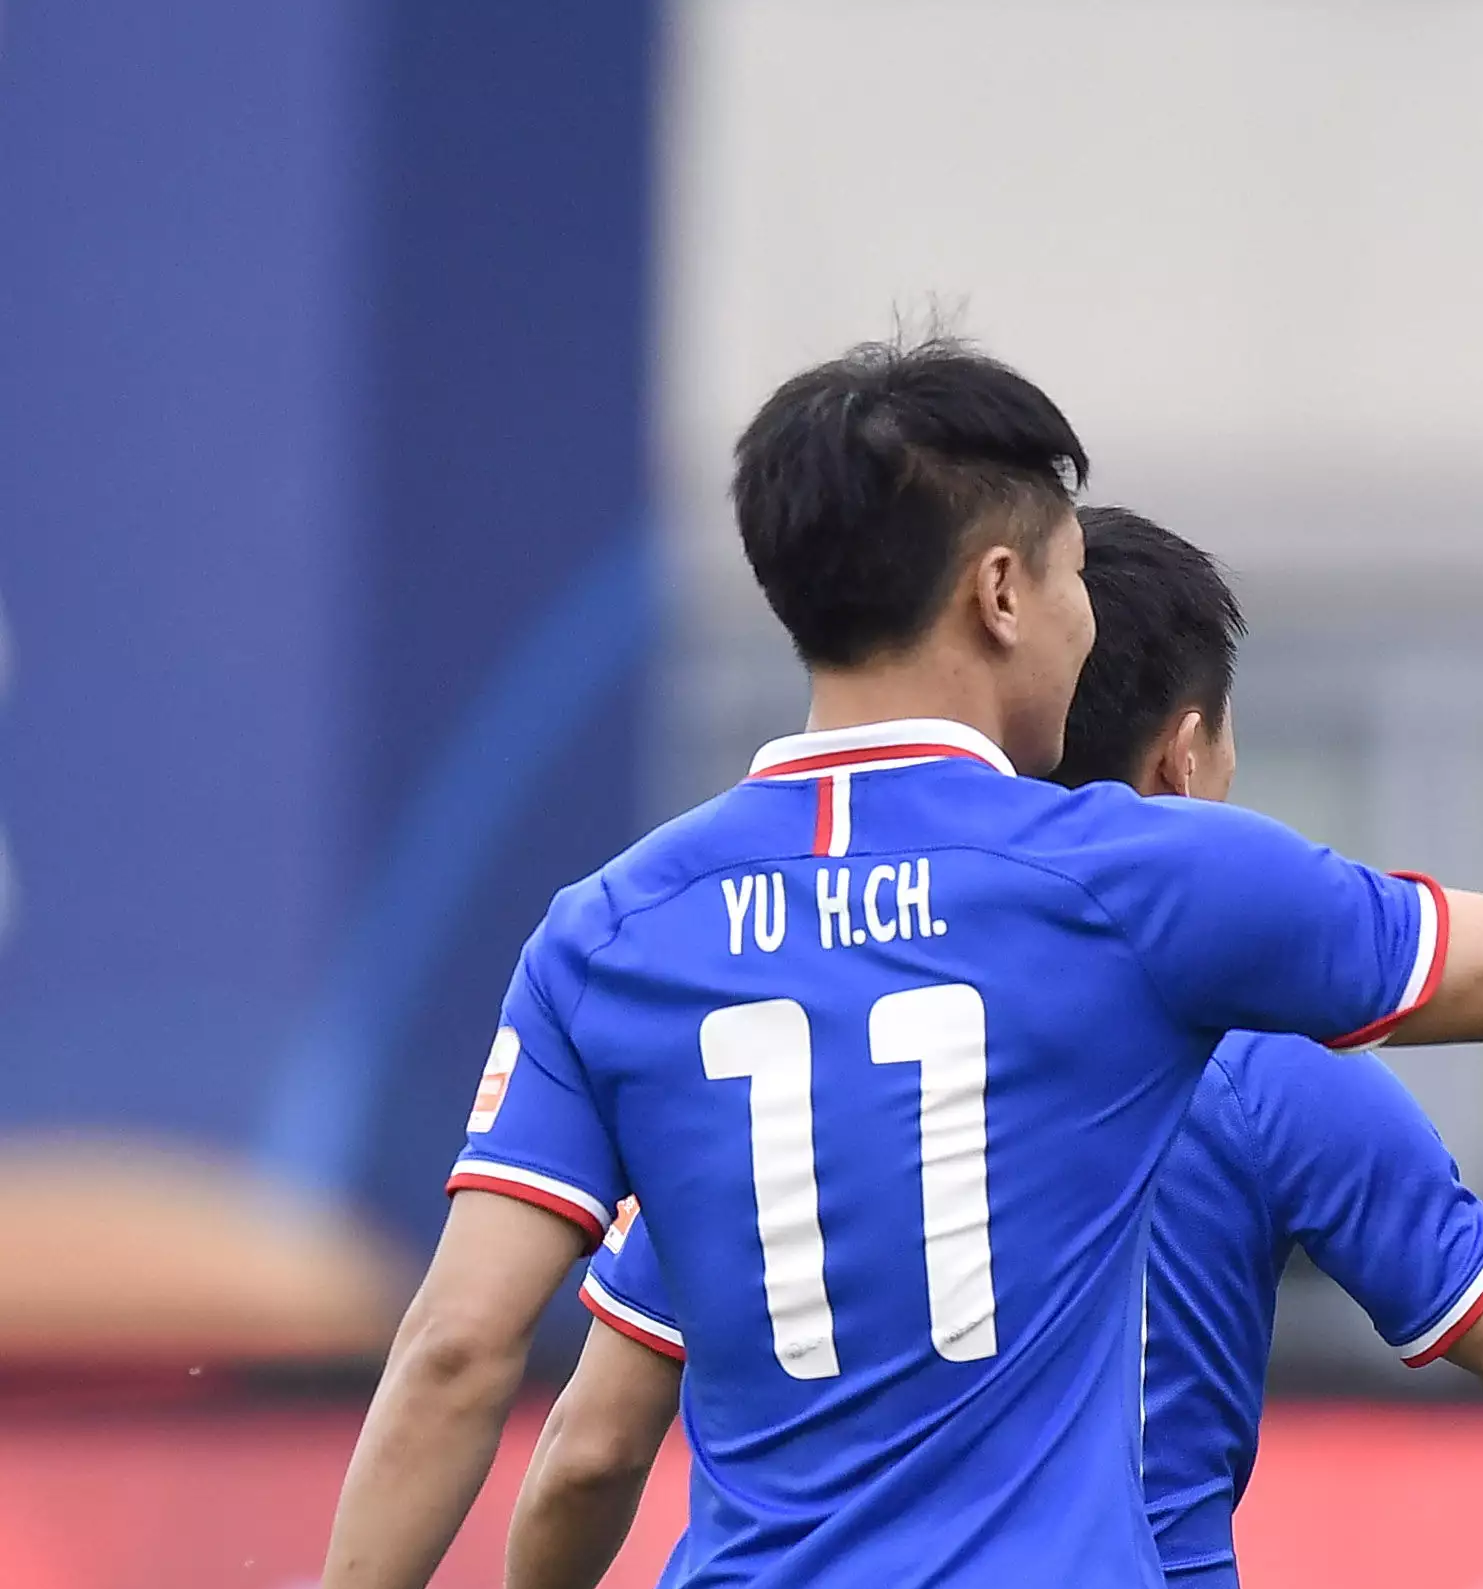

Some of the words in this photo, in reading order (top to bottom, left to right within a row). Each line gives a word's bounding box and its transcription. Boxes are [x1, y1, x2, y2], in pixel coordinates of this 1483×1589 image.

[721, 871, 786, 955] YU
[816, 857, 948, 950] H.CH.
[699, 982, 998, 1380] 11
